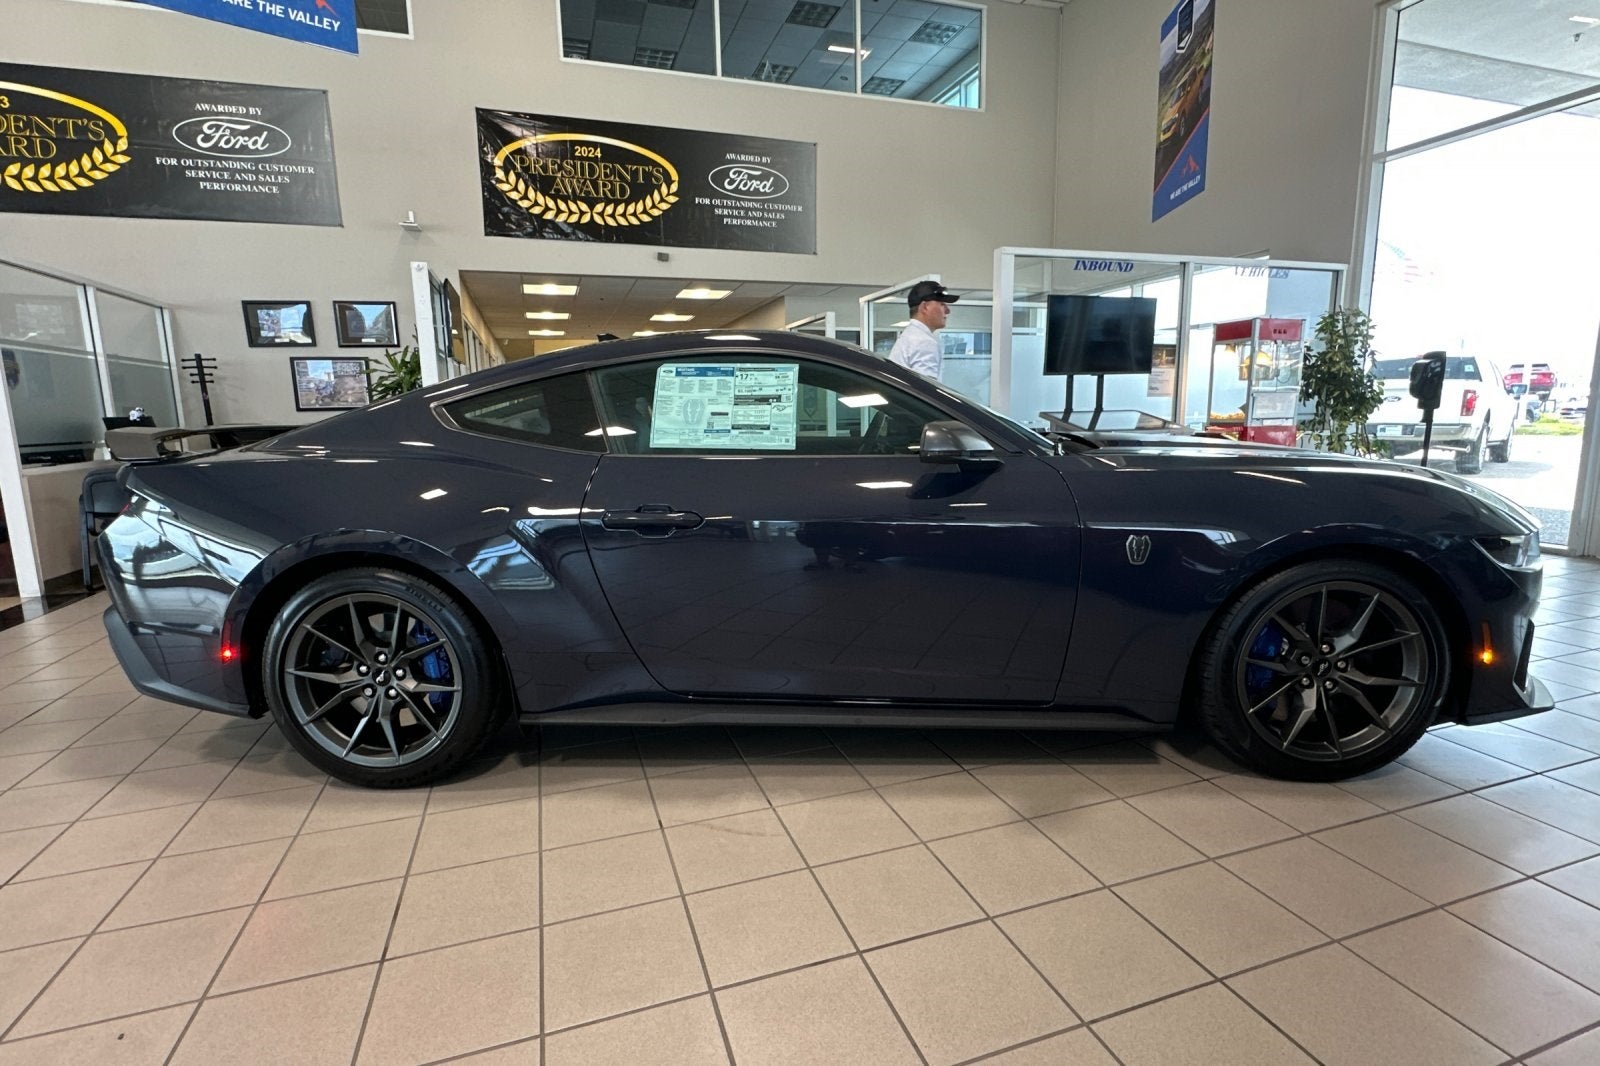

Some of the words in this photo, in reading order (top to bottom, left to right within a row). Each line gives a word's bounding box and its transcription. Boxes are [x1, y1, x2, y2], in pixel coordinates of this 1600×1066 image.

[222, 0, 253, 9] RE
[256, 0, 285, 17] THE
[288, 8, 340, 31] VALLEY
[194, 103, 246, 114] AWARDED
[250, 107, 262, 115] BY
[196, 121, 269, 150] Ford
[574, 146, 601, 158] 2024
[725, 153, 760, 163] AWARDED
[762, 156, 771, 164] BY
[155, 157, 178, 166] FOR
[181, 158, 255, 171] OUTSTANDING
[258, 163, 315, 174] CUSTOMER
[514, 155, 664, 185] PRESIDENT'S
[185, 170, 231, 180] SERVICE
[234, 173, 256, 182] AND
[258, 174, 290, 184] SALES
[724, 168, 774, 193] Ford
[199, 181, 280, 194] PERFORMANCE
[550, 177, 630, 200] AWARD
[695, 197, 710, 205] FOR
[712, 199, 762, 209] OUTSTANDING
[764, 203, 803, 212] CUSTOMER
[714, 208, 745, 217] SERVICE
[763, 211, 785, 219] SALES
[723, 218, 777, 228] PERFORMANCE
[1073, 259, 1134, 272] INBOUND
